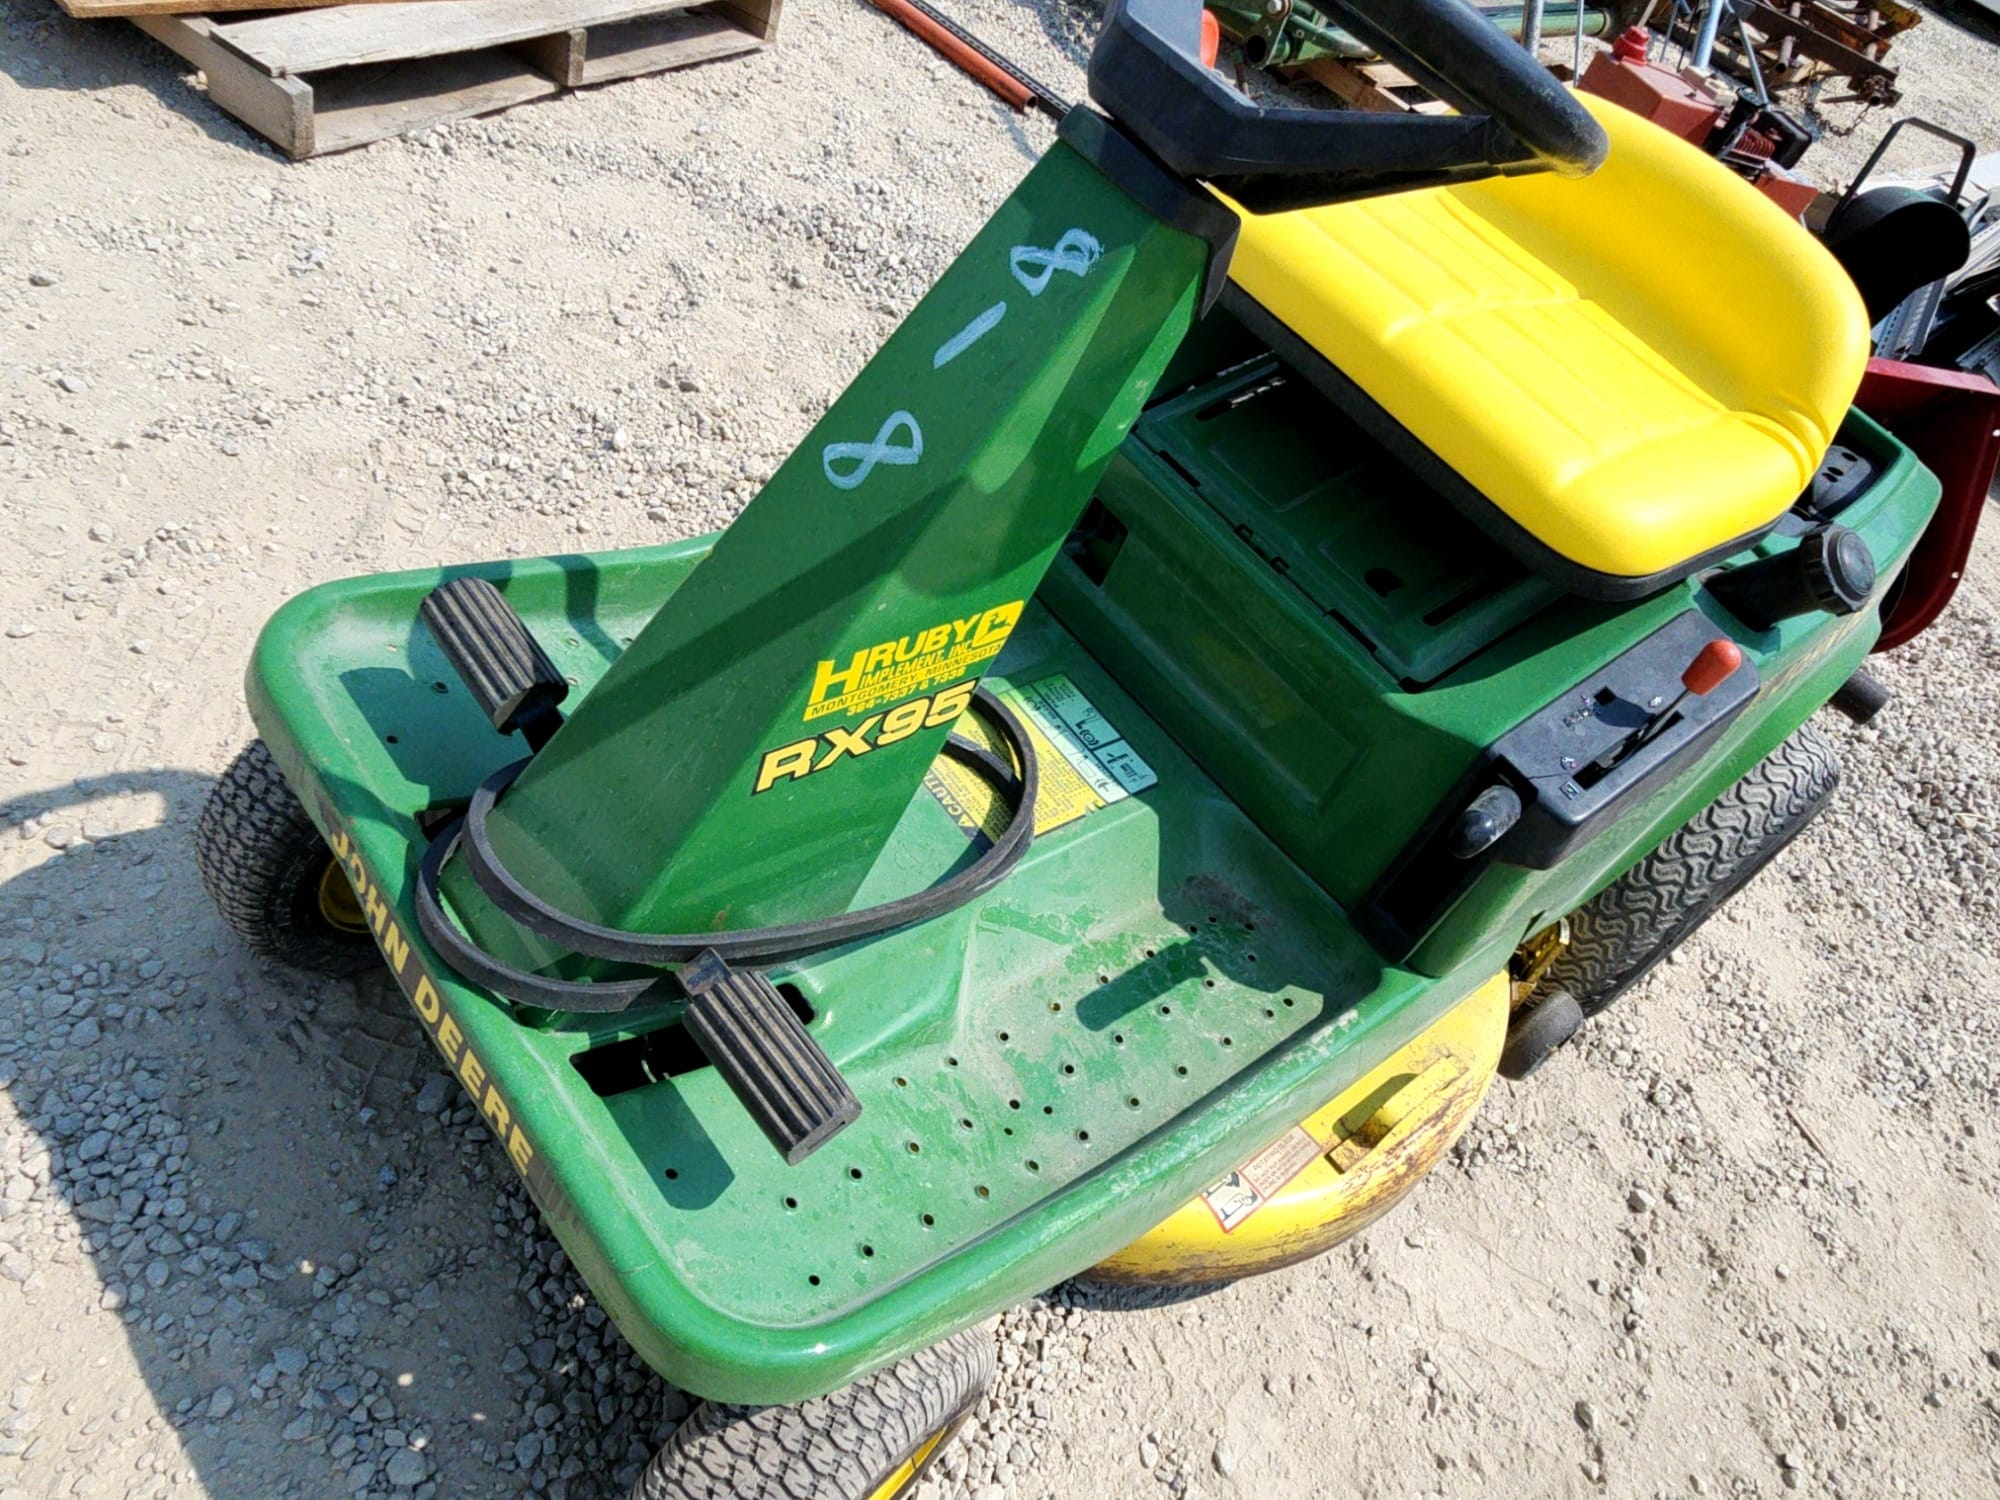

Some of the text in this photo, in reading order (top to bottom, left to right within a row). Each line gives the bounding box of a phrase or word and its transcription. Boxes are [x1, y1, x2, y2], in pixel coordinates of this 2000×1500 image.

[808, 613, 981, 705] HRUBY
[925, 643, 1001, 676] MINNESOTA
[751, 678, 980, 796] RX95
[925, 773, 963, 815] CAUTI
[330, 831, 534, 1177] JOHN DEERE
